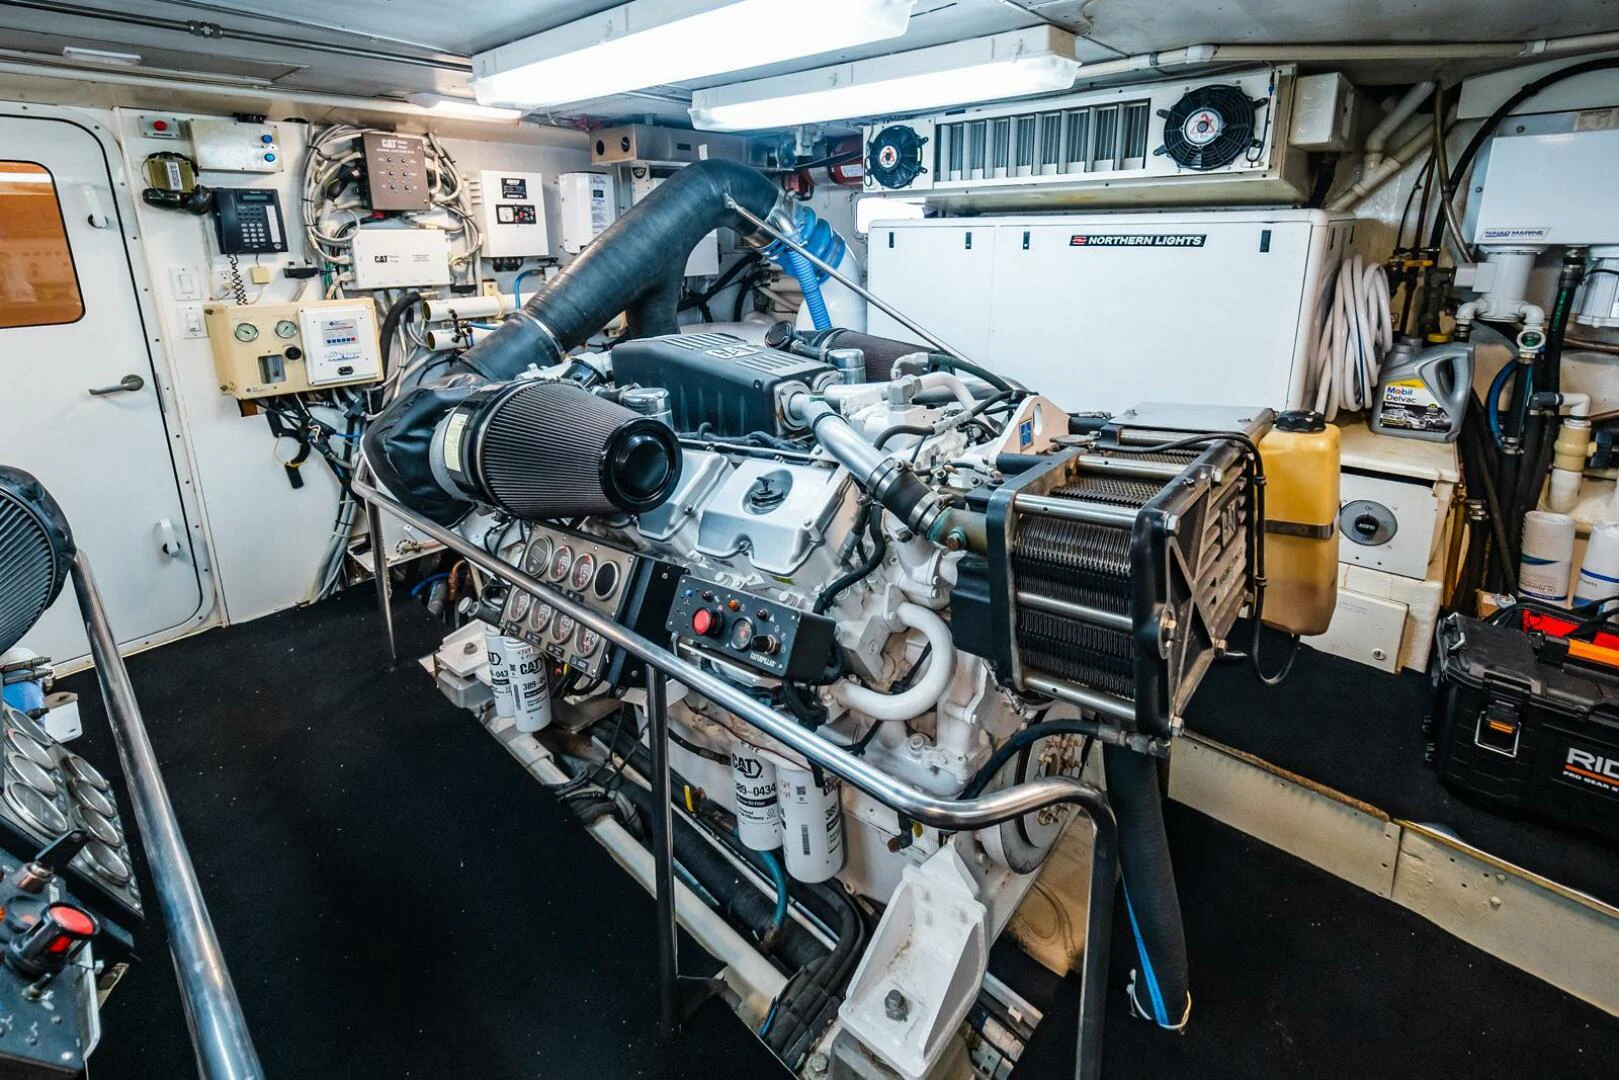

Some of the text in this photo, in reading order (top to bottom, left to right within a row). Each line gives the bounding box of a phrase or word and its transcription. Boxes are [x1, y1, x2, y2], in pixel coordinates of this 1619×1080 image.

[1088, 236, 1202, 246] NORTHERN LIGHTS
[374, 255, 388, 264] CAT
[1387, 386, 1413, 396] Mobil
[1386, 394, 1416, 404] Delvac
[520, 657, 543, 675] CAT
[732, 753, 763, 779] CAT
[1563, 770, 1582, 780] PRO
[1583, 777, 1609, 789] GEAR
[736, 781, 777, 797] 89-0434
